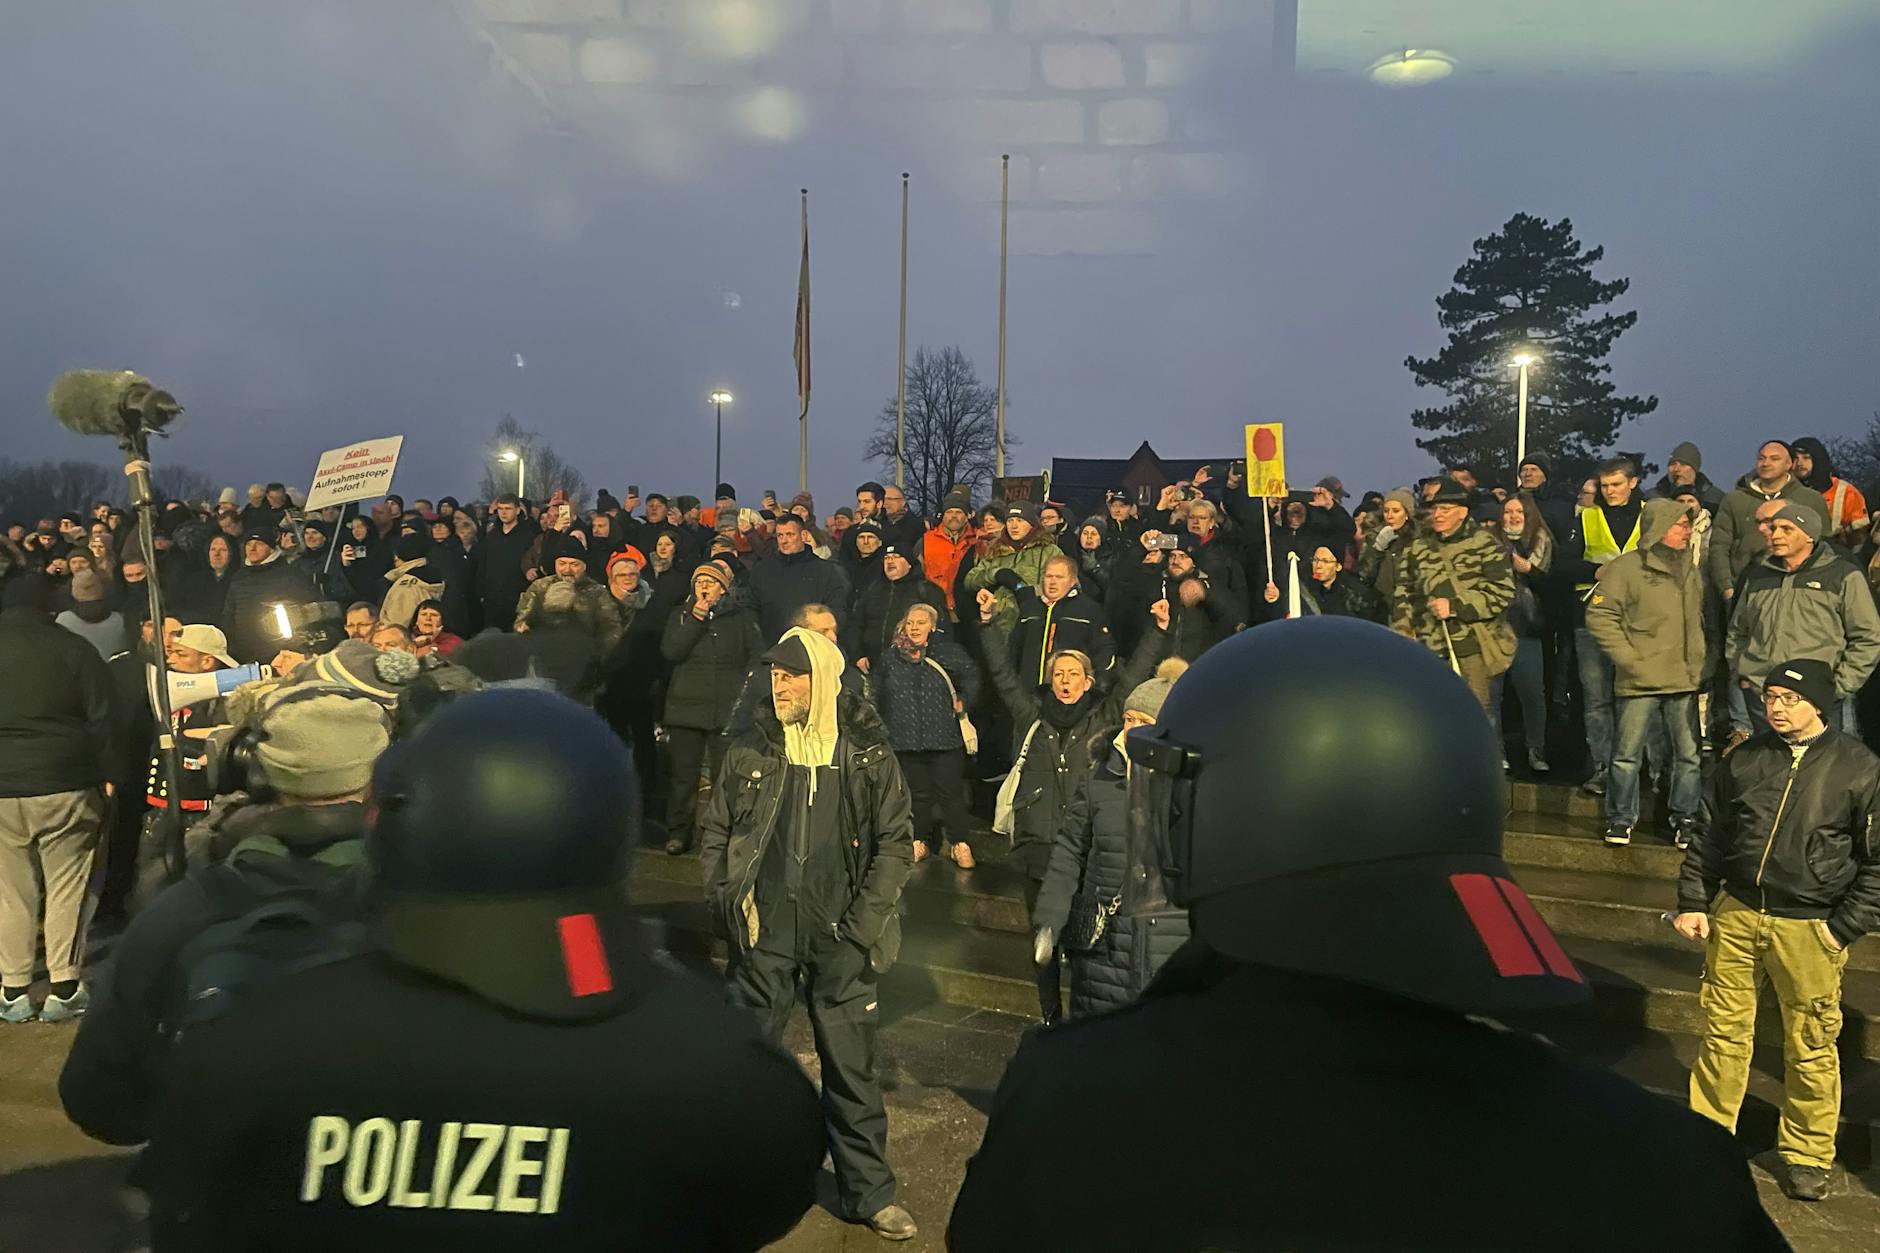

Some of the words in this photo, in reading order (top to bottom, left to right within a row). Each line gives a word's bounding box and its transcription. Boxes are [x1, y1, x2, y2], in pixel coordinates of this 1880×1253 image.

[344, 448, 370, 460] Kein
[315, 468, 389, 490] Aufnahmestopp
[301, 1115, 570, 1214] POLIZEI
